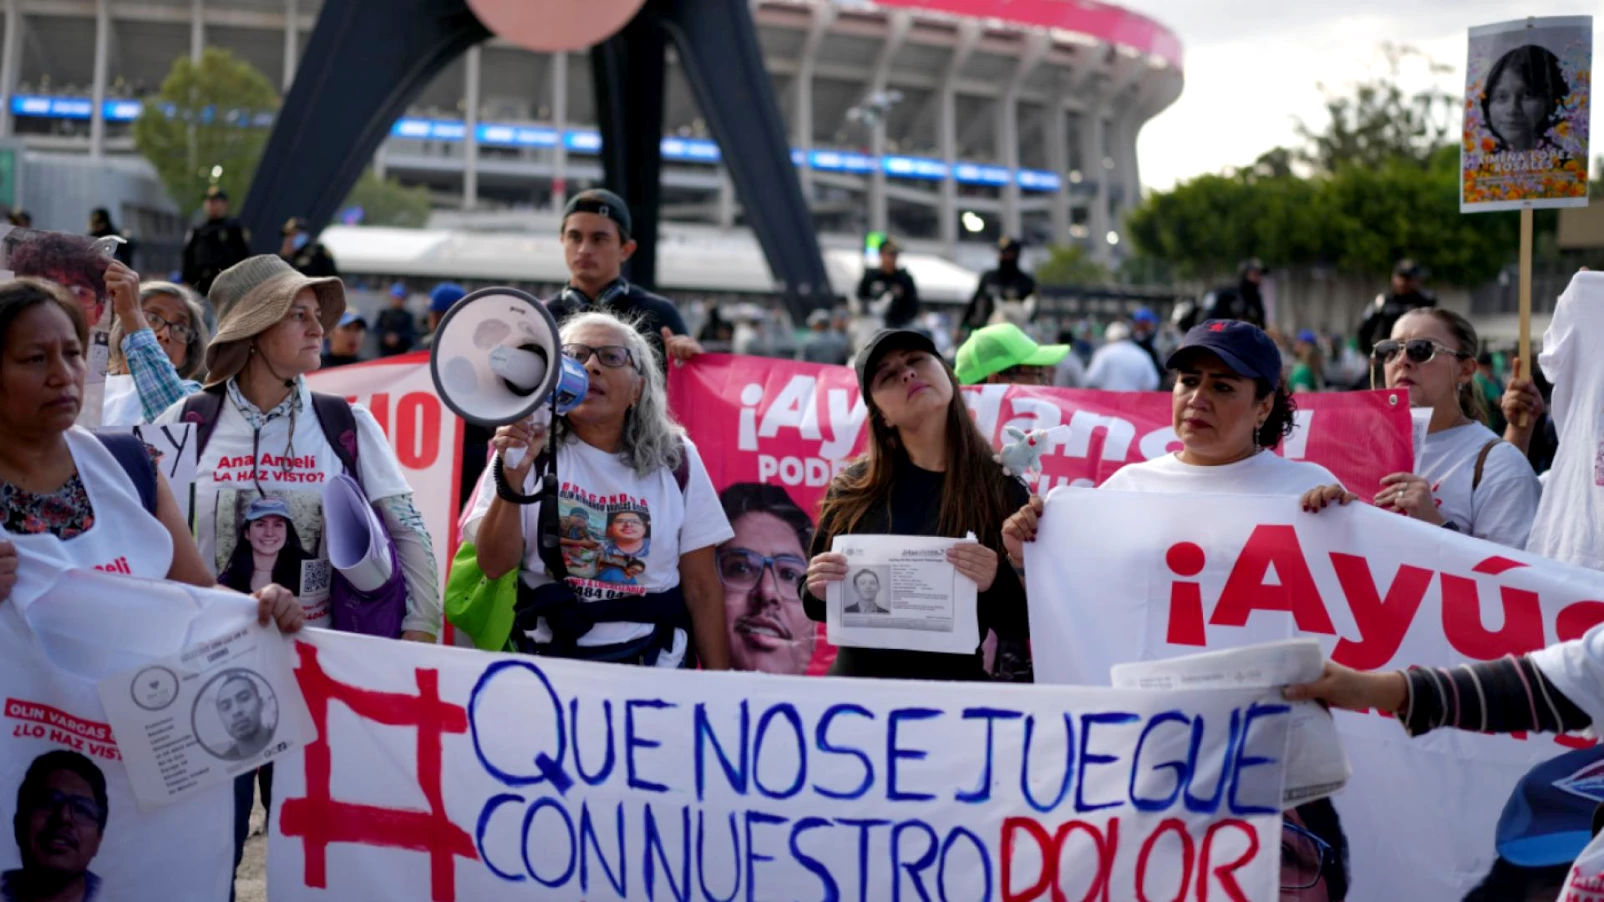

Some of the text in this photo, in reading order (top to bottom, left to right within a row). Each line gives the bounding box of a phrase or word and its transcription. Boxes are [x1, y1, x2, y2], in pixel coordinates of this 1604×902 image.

[217, 453, 315, 469] Ana Amelí
[213, 470, 325, 483] LA HAZ VISTO?
[9, 703, 106, 739] OLIN VARGAS
[13, 723, 46, 738] ¿LO
[50, 729, 84, 751] HAZ
